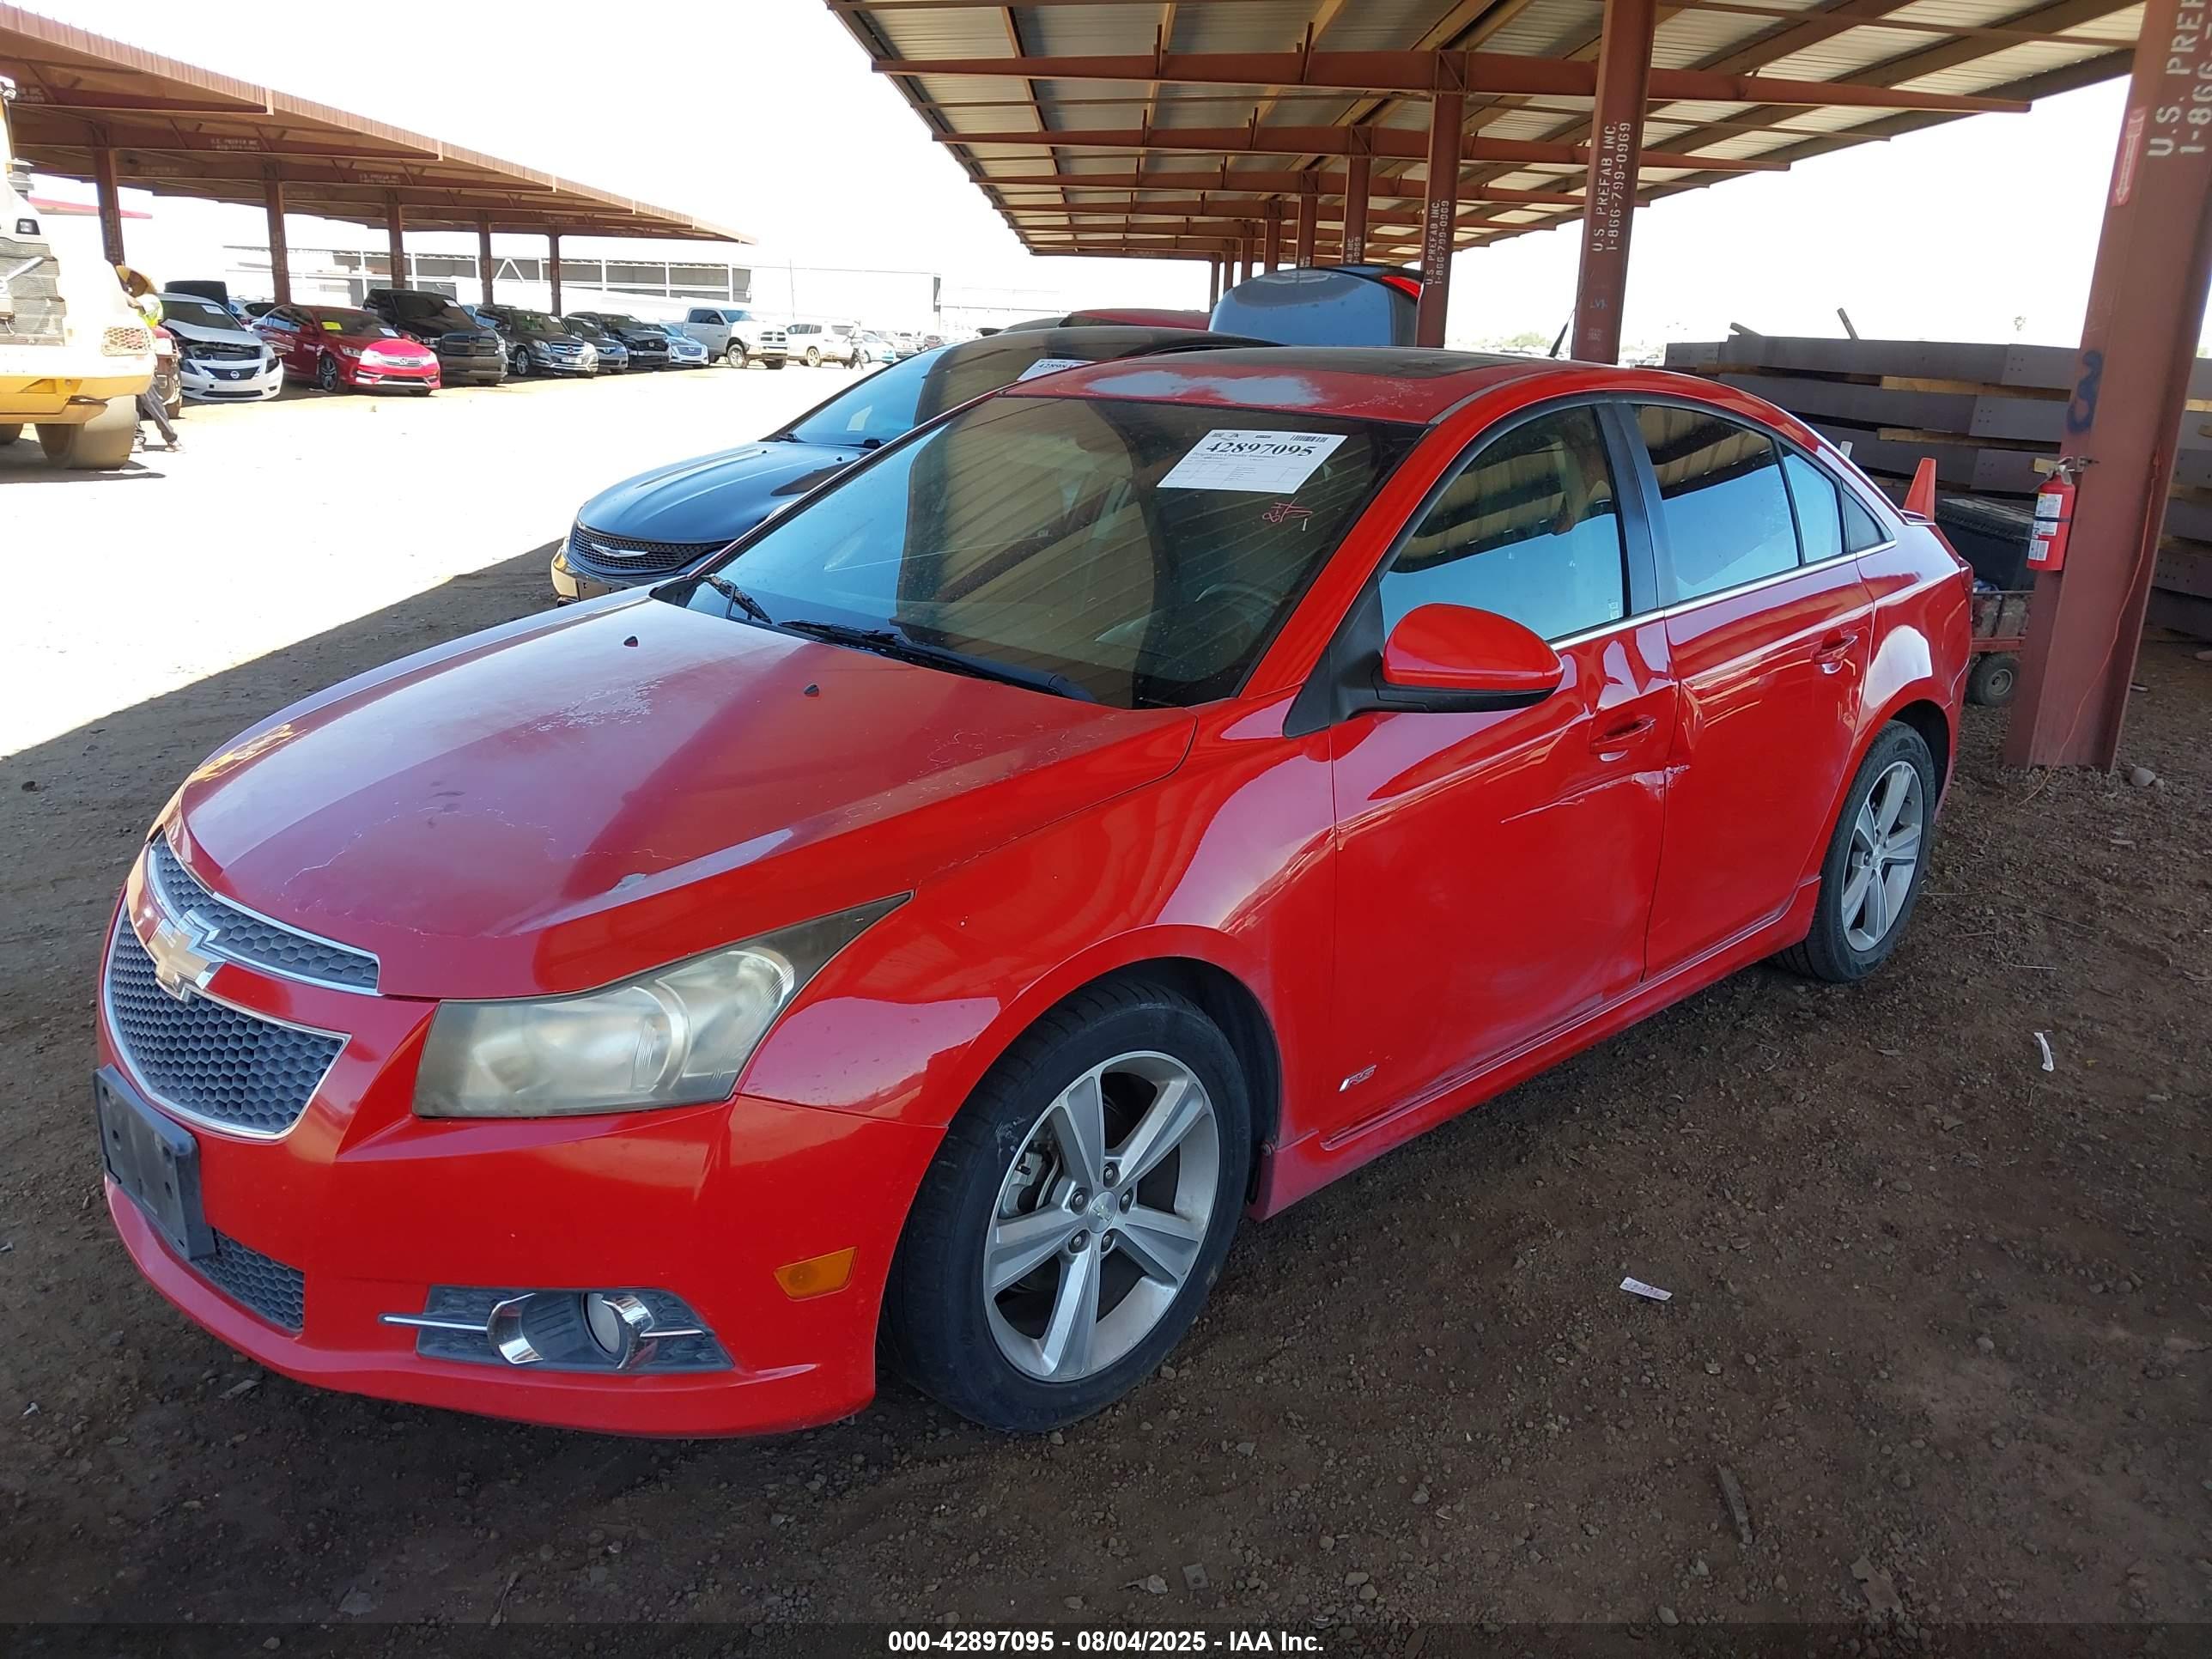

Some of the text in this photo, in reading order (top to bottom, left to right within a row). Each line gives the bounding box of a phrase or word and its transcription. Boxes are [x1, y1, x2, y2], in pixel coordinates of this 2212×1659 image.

[1603, 121, 1618, 149] INC.
[1595, 157, 1613, 216] PREFAB
[1606, 122, 1631, 251] 1-866-799-0969
[1431, 199, 1441, 218] INC.
[1427, 223, 1438, 261] PREFAB
[1206, 441, 1316, 456] 42897095
